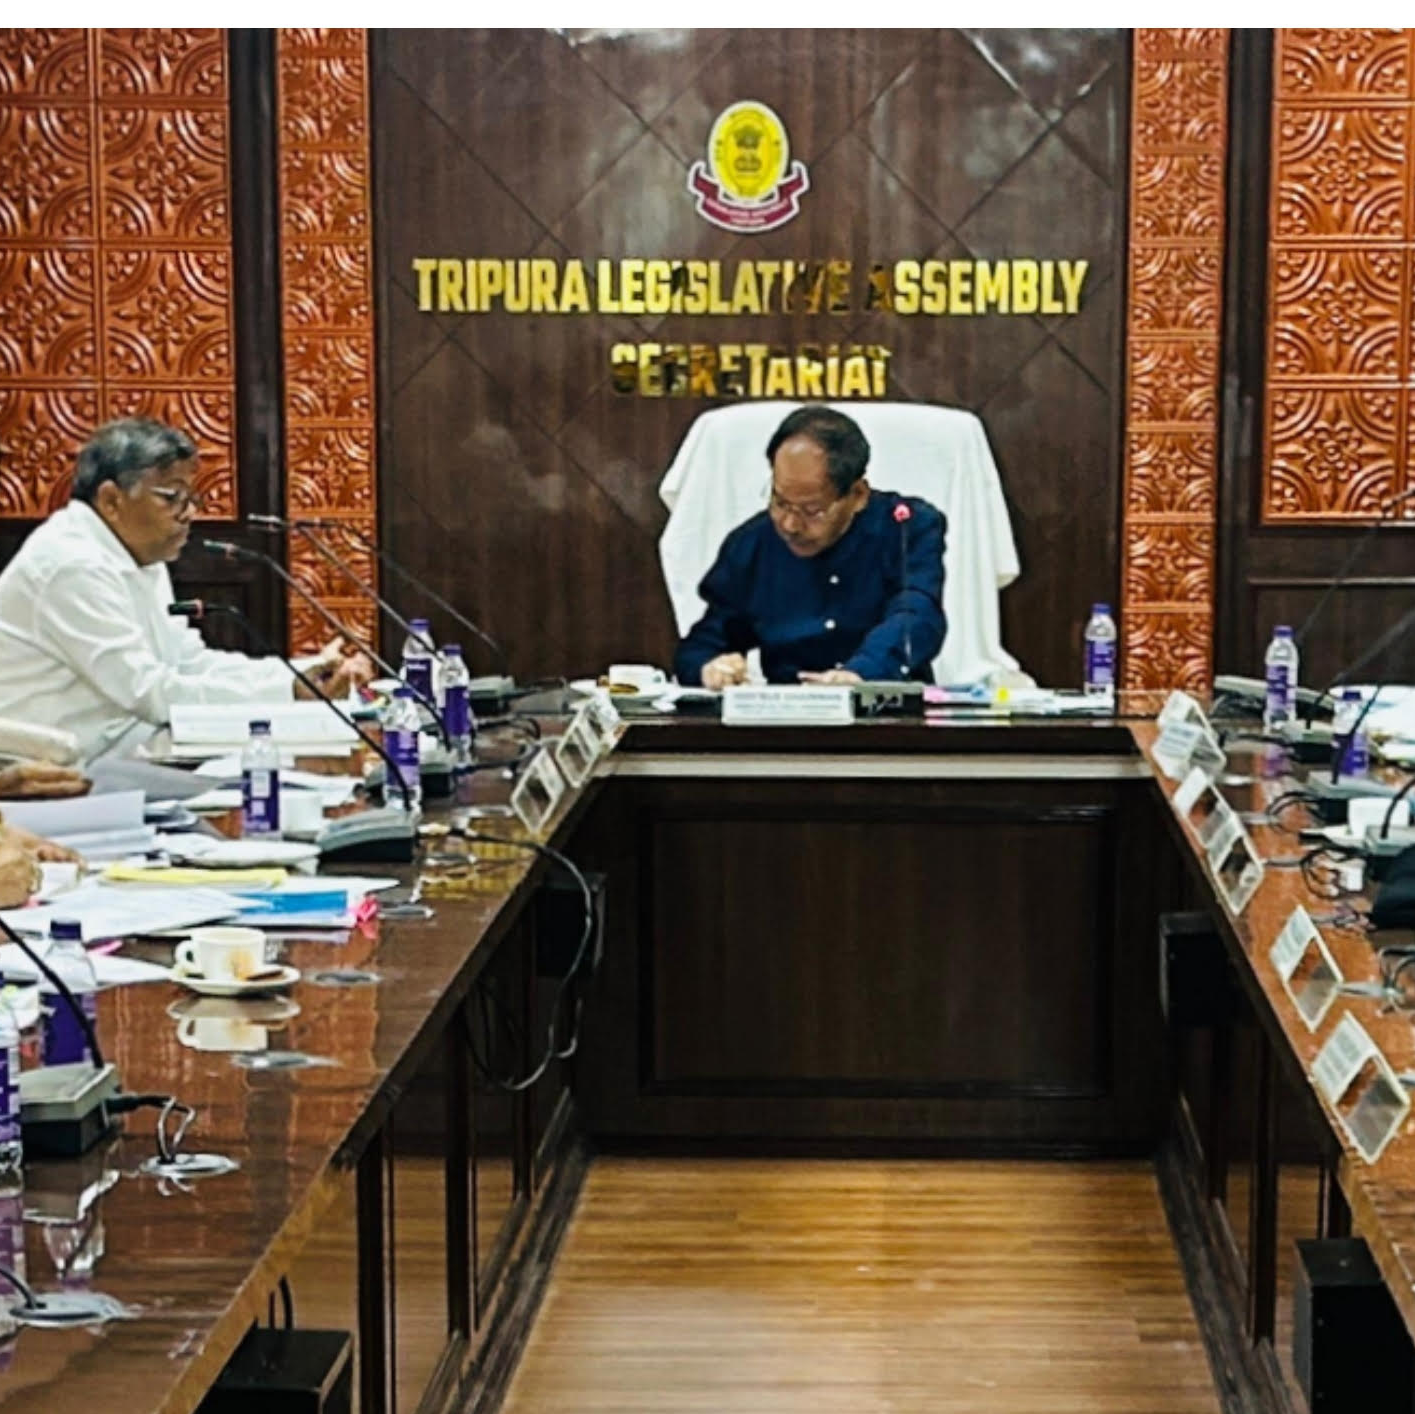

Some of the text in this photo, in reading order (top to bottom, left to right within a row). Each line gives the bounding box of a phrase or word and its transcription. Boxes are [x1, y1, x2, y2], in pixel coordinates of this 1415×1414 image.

[412, 258, 1089, 315] TRIPURA LEGISLATIVE ASSEMBLY
[611, 343, 892, 398] SECRETARIAT
